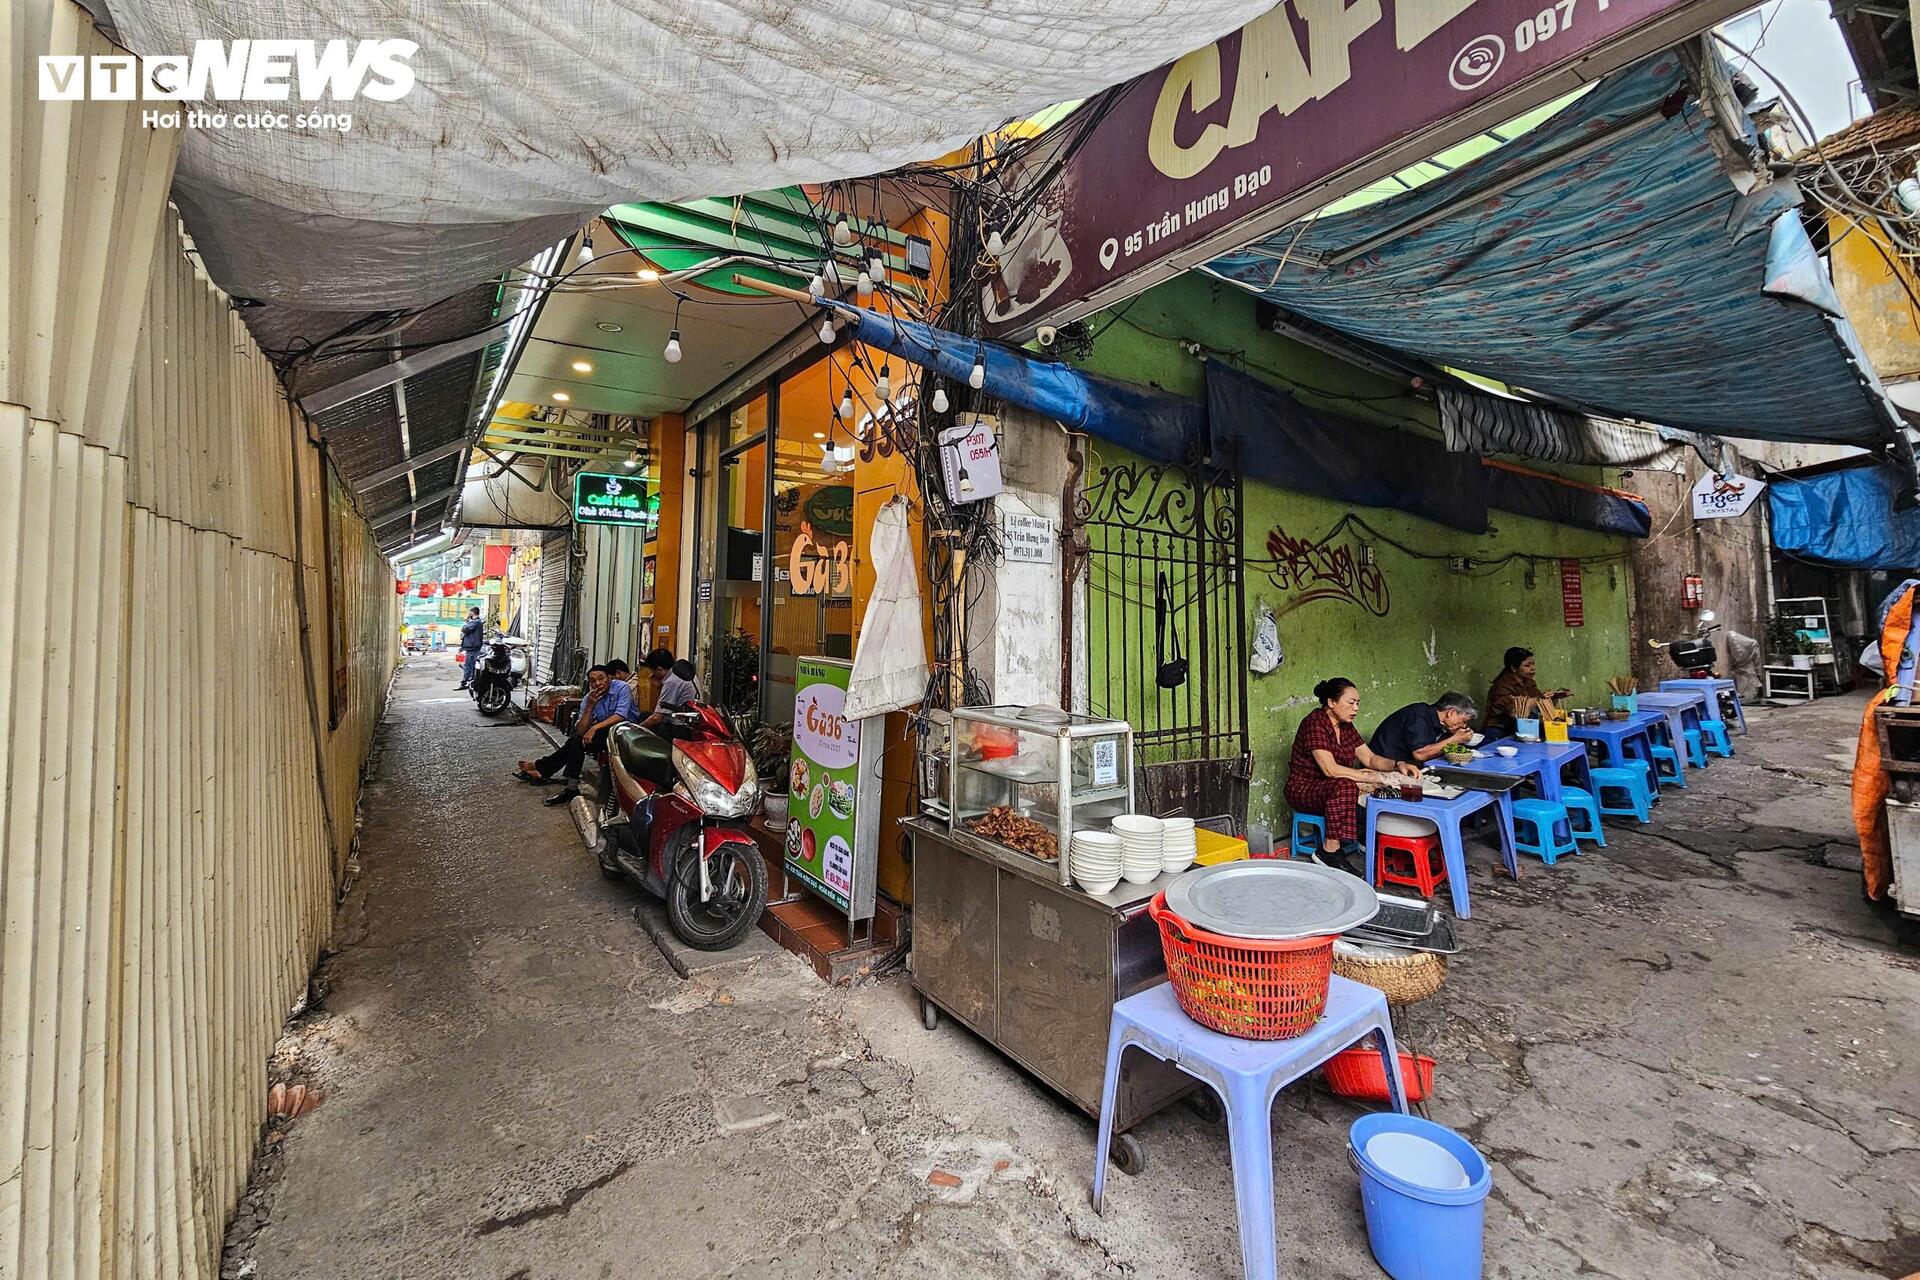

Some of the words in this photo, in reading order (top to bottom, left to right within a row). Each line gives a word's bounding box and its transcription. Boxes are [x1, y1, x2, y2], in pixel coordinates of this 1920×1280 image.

[1124, 230, 1143, 257] 95
[1146, 210, 1181, 245] Trần
[1185, 186, 1230, 226] Hưng
[1233, 164, 1272, 197] Đạo
[966, 433, 985, 447] P307
[1699, 493, 1745, 508] Tiger
